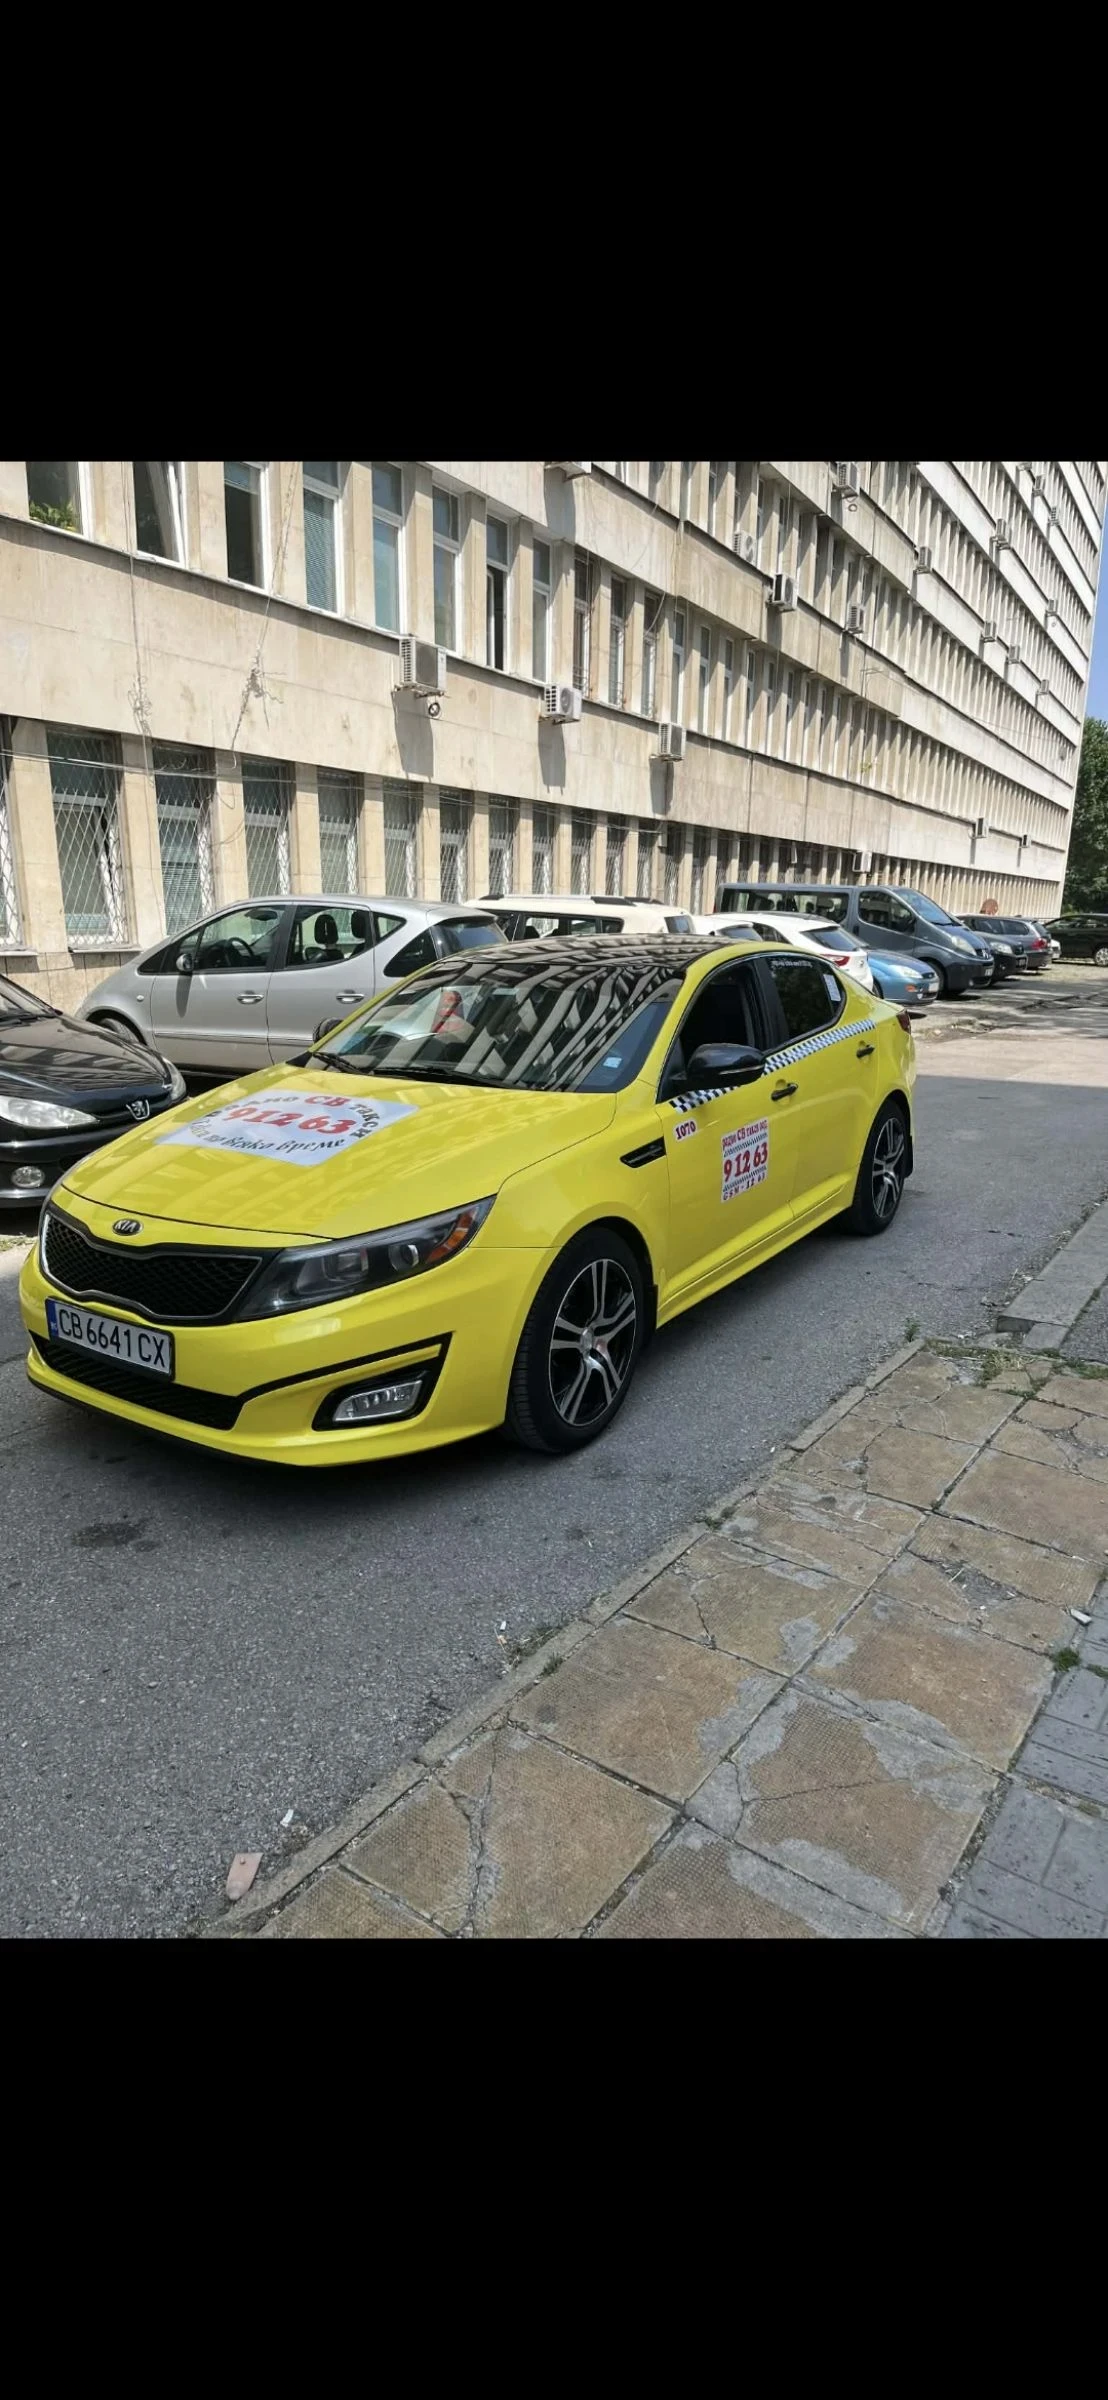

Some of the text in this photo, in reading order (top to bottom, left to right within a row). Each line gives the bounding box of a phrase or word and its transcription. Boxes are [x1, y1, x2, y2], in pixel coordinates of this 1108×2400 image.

[675, 1120, 697, 1140] 1070
[114, 1222, 137, 1233] KIA
[58, 1308, 166, 1368] CB 6641 CX
